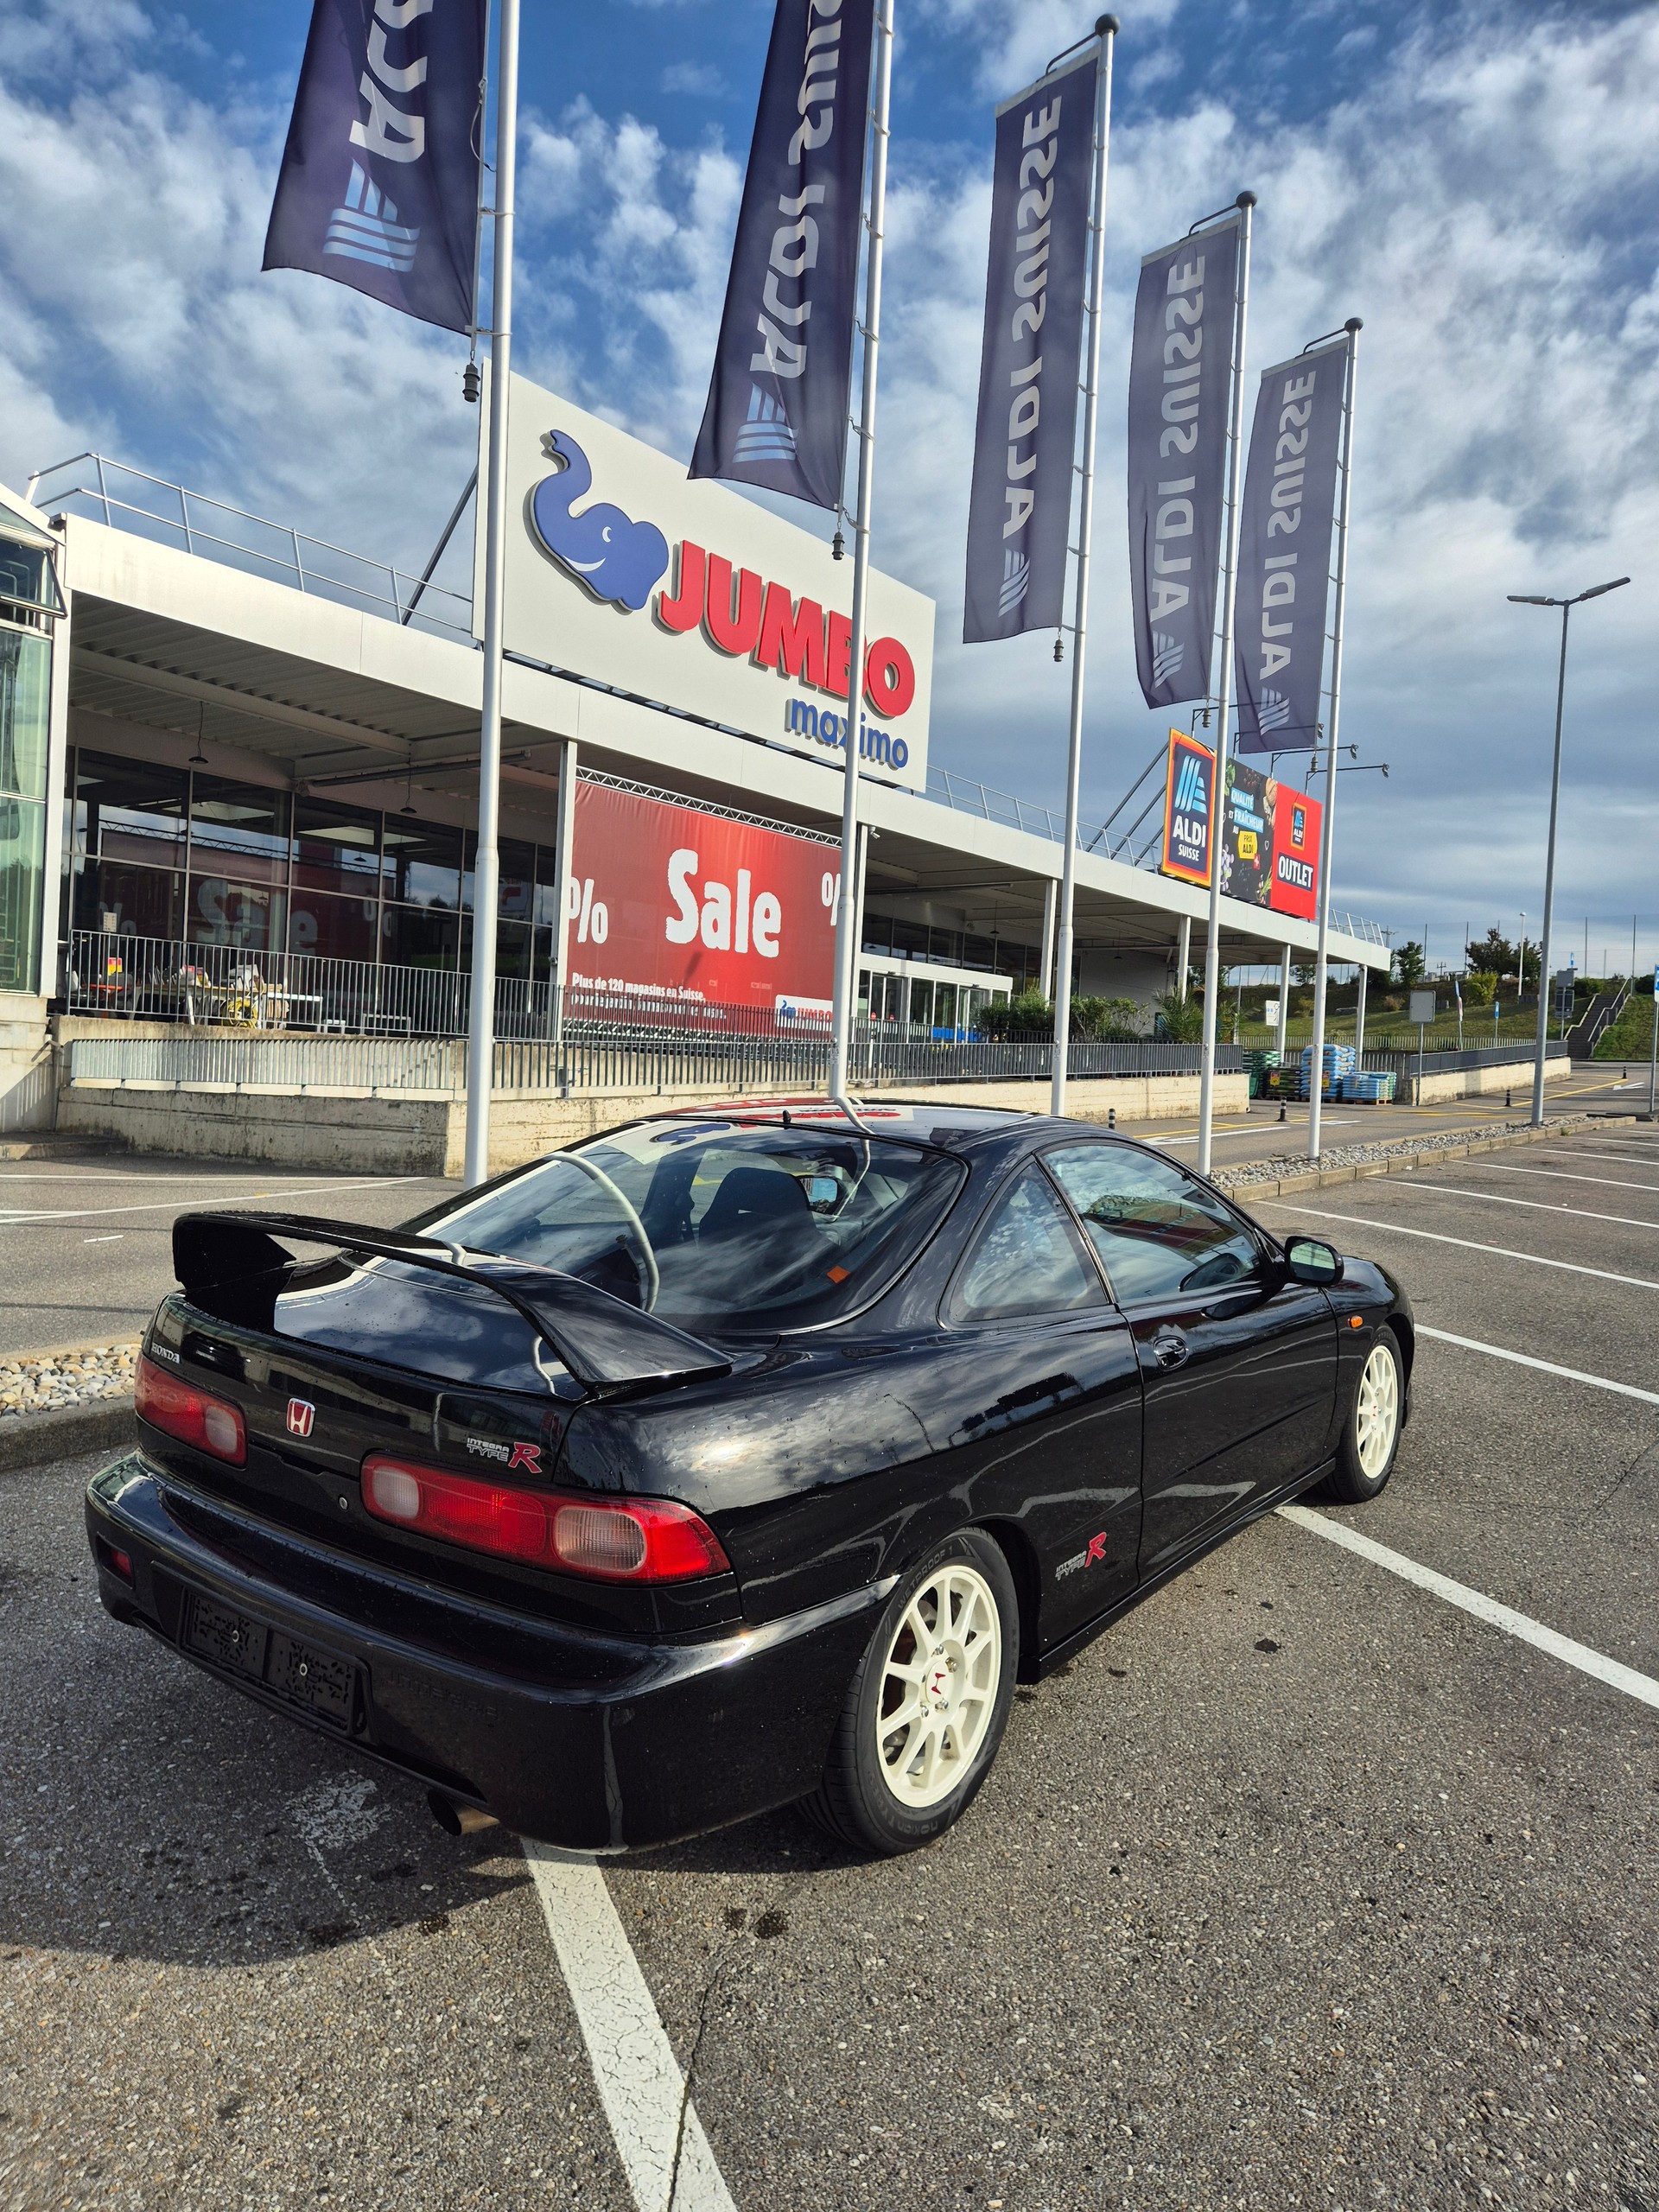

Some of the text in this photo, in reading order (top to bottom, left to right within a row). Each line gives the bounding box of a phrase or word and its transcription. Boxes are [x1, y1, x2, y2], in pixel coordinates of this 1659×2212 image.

[659, 539, 915, 717] JUMBO
[1173, 814, 1207, 849] ALDI
[1178, 843, 1199, 861] SUISSE
[1278, 855, 1314, 888] OUTLET
[665, 848, 782, 958] Sale
[572, 972, 594, 988] Plus
[594, 976, 607, 991] de
[607, 977, 624, 992] 120
[625, 982, 665, 1000] magasins
[666, 987, 677, 999] en
[151, 1343, 181, 1364] HONDA
[467, 1437, 510, 1452] INTEGRA
[467, 1441, 543, 1474] TYPE R
[1055, 1531, 1107, 1581] TYPE R
[898, 1549, 946, 1609] WETPROOF
